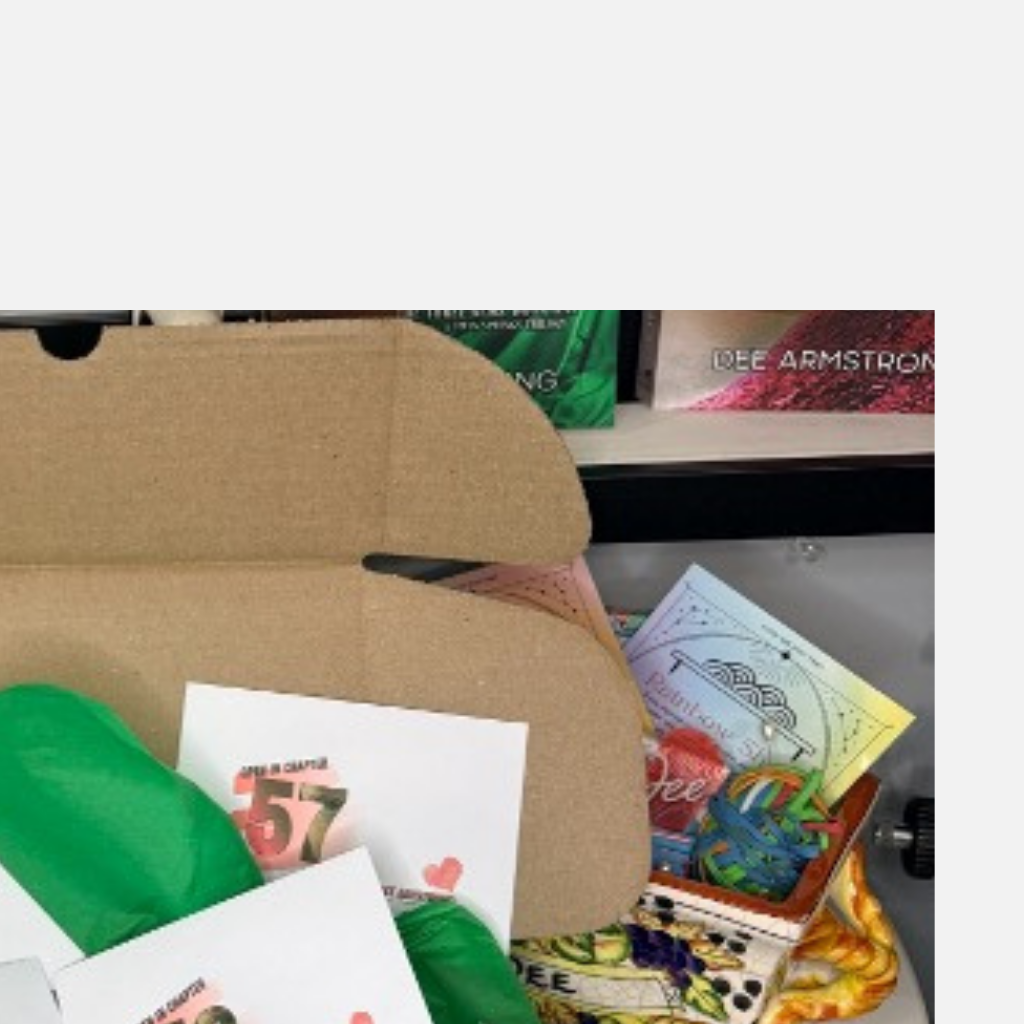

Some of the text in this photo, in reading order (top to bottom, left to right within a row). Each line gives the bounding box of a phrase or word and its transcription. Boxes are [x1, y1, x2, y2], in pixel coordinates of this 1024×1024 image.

[713, 349, 935, 374] DEE ARMSTRON
[246, 777, 349, 864] 57
